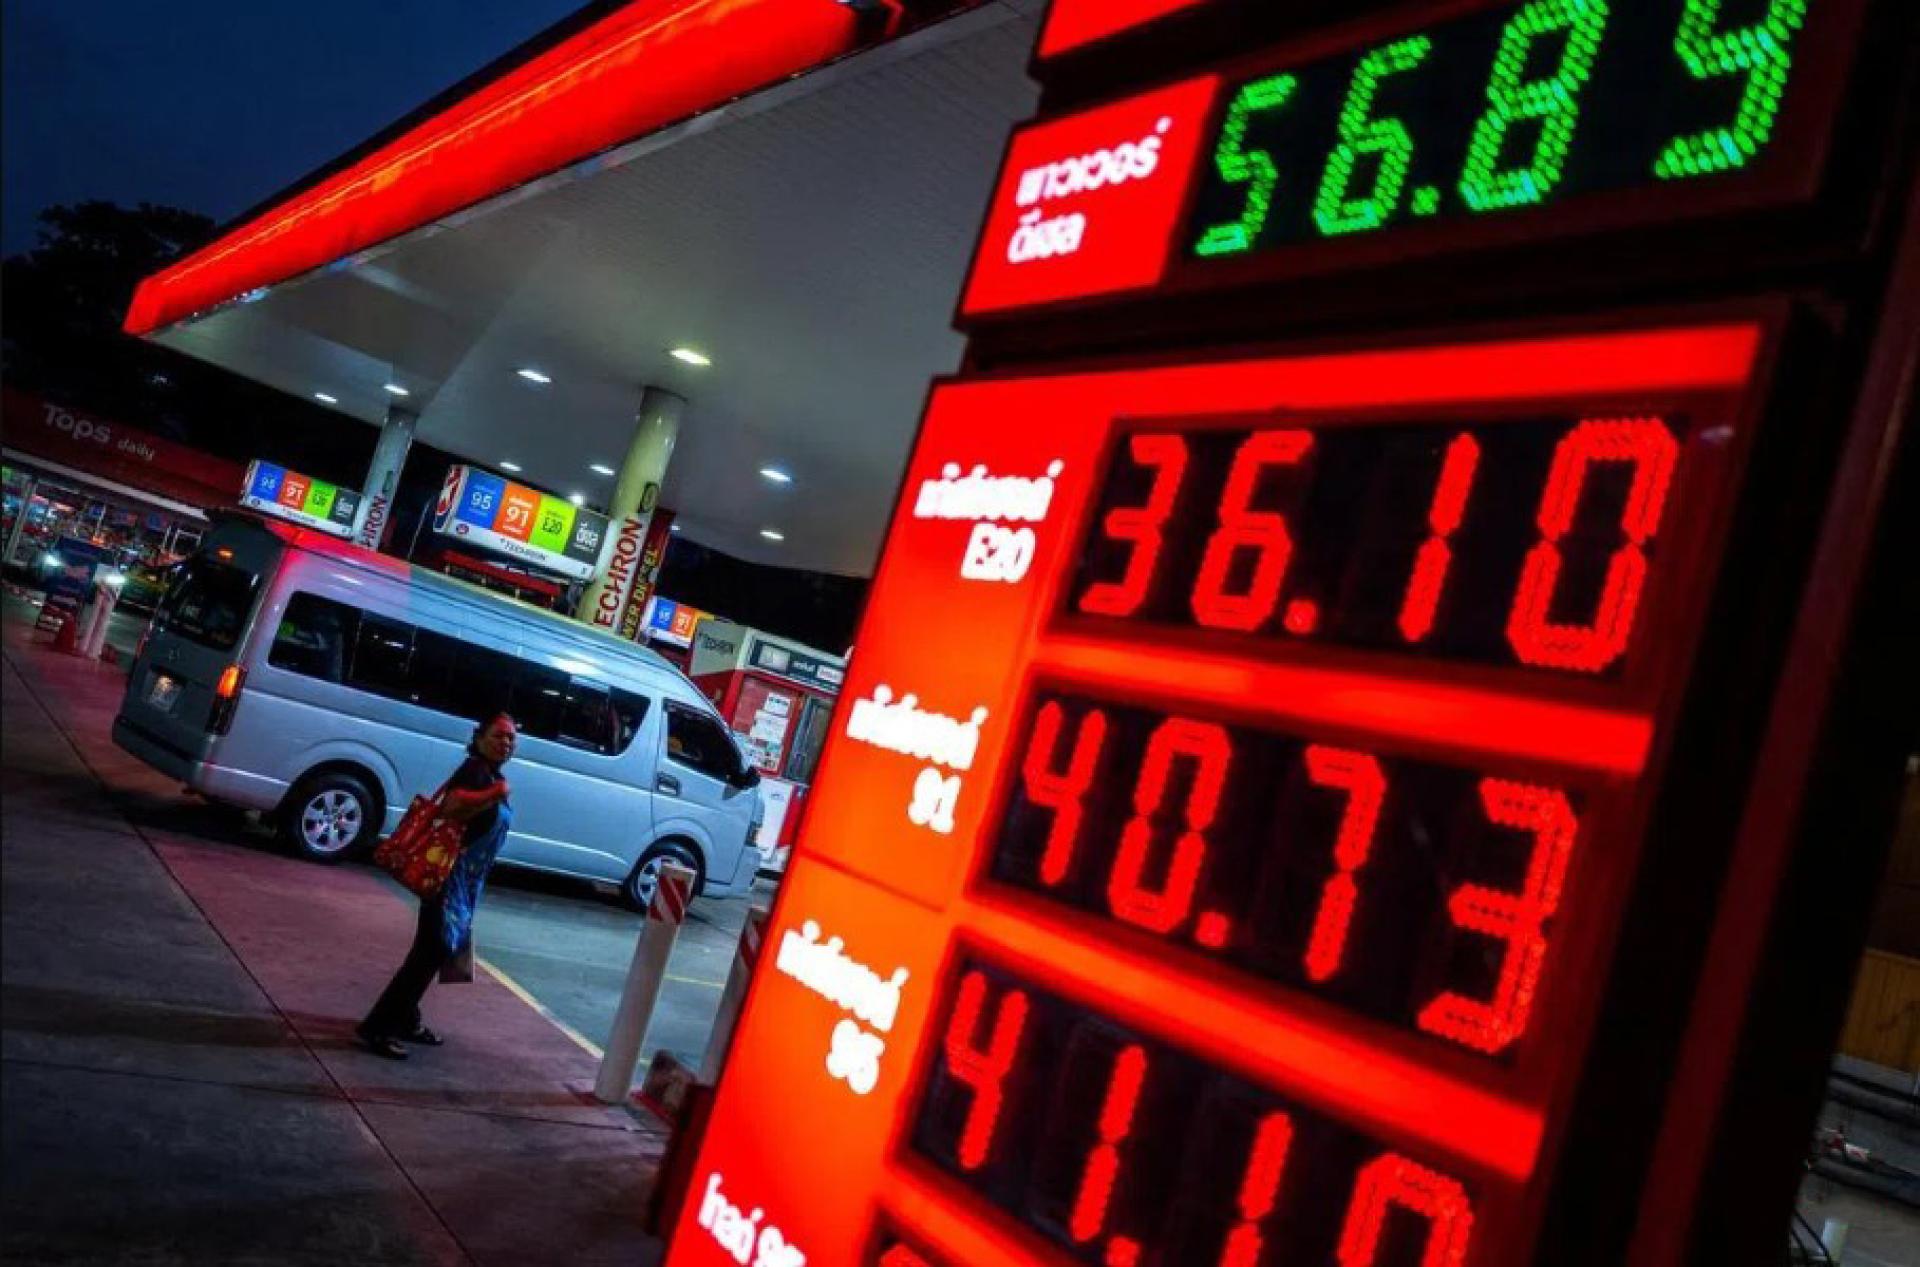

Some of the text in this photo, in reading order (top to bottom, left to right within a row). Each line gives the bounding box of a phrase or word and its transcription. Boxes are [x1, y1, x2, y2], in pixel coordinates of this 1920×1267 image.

[43, 403, 112, 443] Tops
[471, 491, 493, 510] 95
[506, 506, 529, 527] 91
[1080, 417, 1680, 671] 36.10
[1022, 700, 1580, 1053] 40.73
